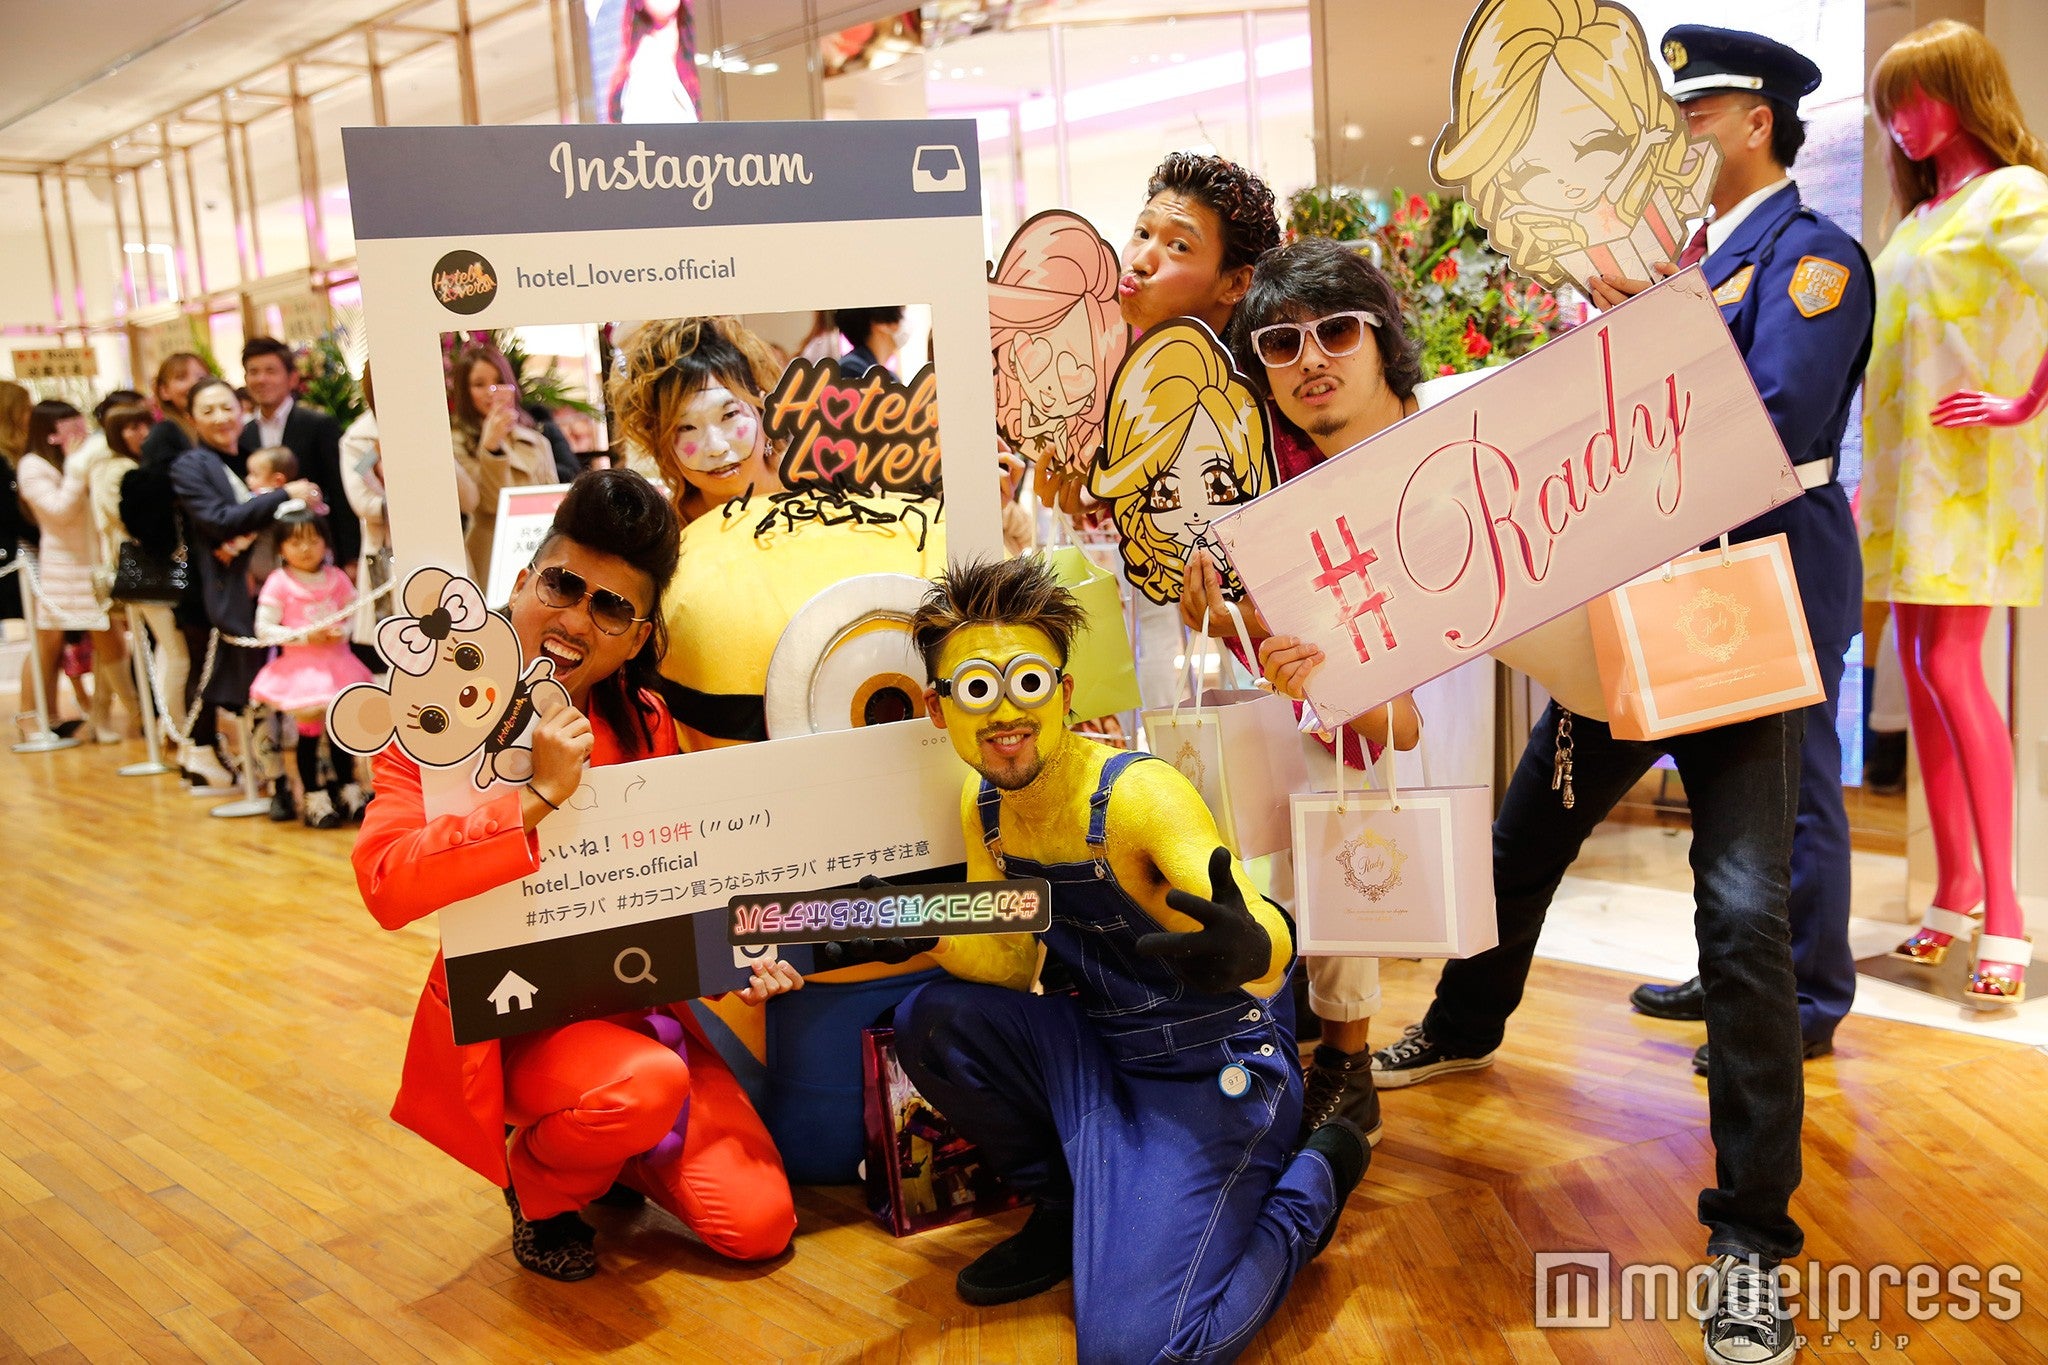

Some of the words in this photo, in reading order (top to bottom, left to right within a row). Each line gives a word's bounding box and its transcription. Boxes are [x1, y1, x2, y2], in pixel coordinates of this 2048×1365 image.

[549, 139, 814, 211] Instagram
[516, 256, 737, 289] hotel_lovers.official
[787, 420, 942, 484] Lover
[621, 821, 694, 850] 1919件
[522, 850, 699, 897] hotel_lovers.official
[525, 896, 607, 927] #ホテラバ
[616, 859, 818, 910] #カラコン買うならホテラバ
[826, 839, 931, 872] #モテすぎ注意
